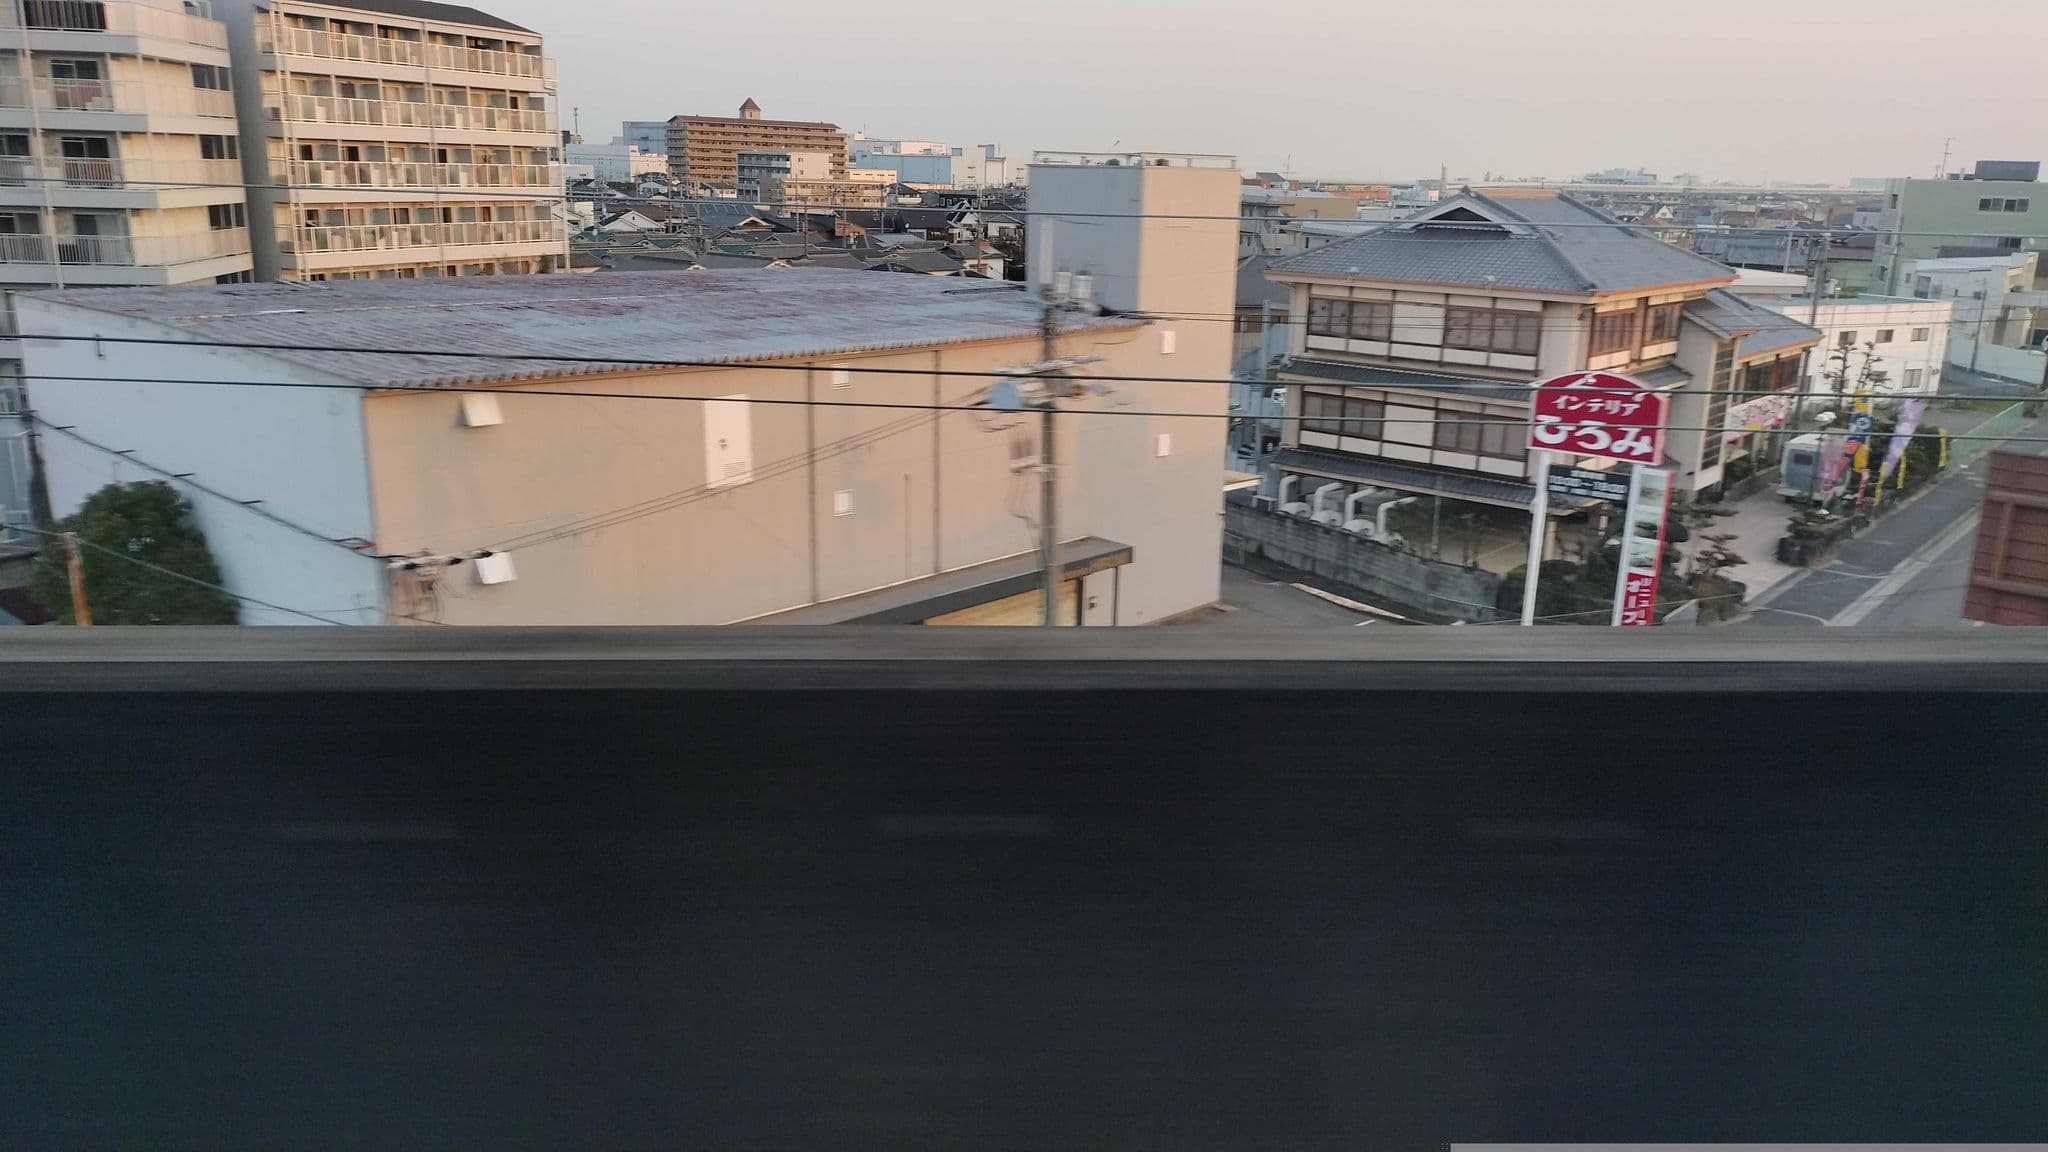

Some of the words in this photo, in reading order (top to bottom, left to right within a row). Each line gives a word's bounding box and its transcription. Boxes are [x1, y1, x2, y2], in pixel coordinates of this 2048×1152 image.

[1551, 395, 1641, 417] インテリア
[1534, 414, 1653, 456] ひろみ
